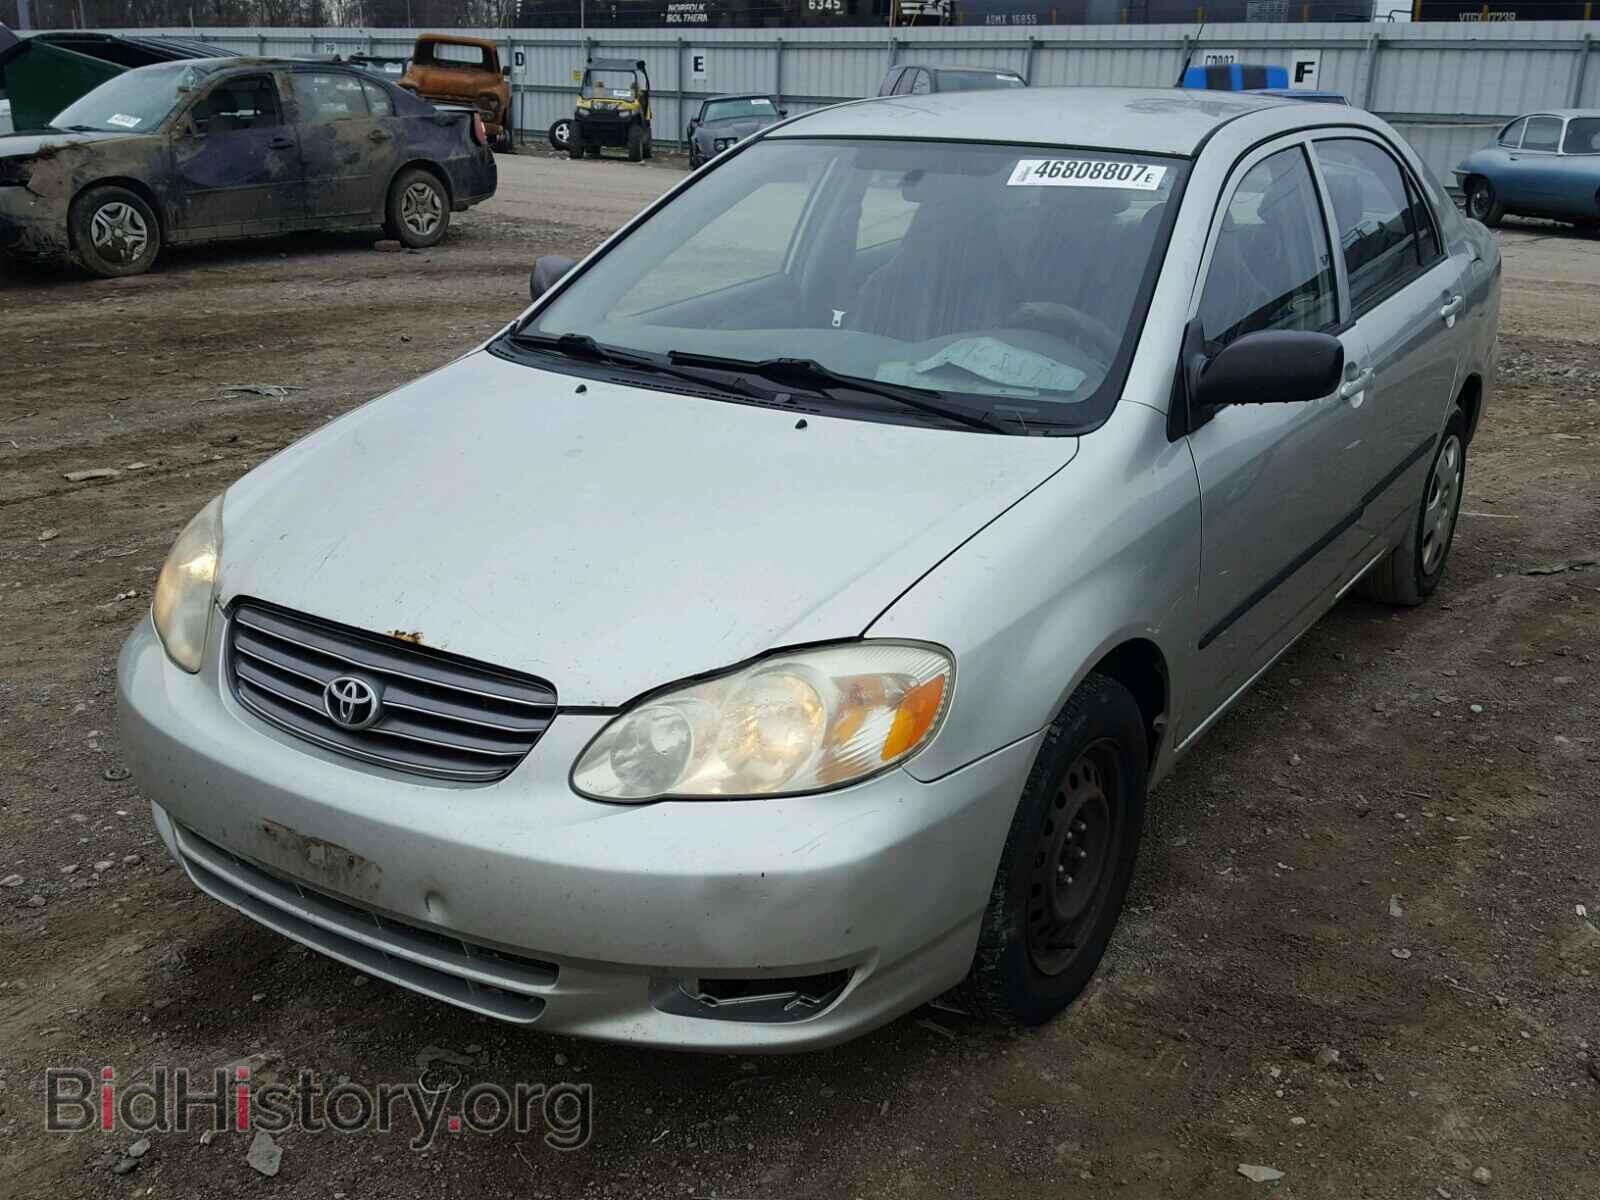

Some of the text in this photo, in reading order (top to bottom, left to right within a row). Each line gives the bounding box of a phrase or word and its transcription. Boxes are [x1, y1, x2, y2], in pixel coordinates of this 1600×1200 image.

[515, 52, 525, 66] D
[693, 56, 704, 72] E
[1294, 61, 1315, 83] F
